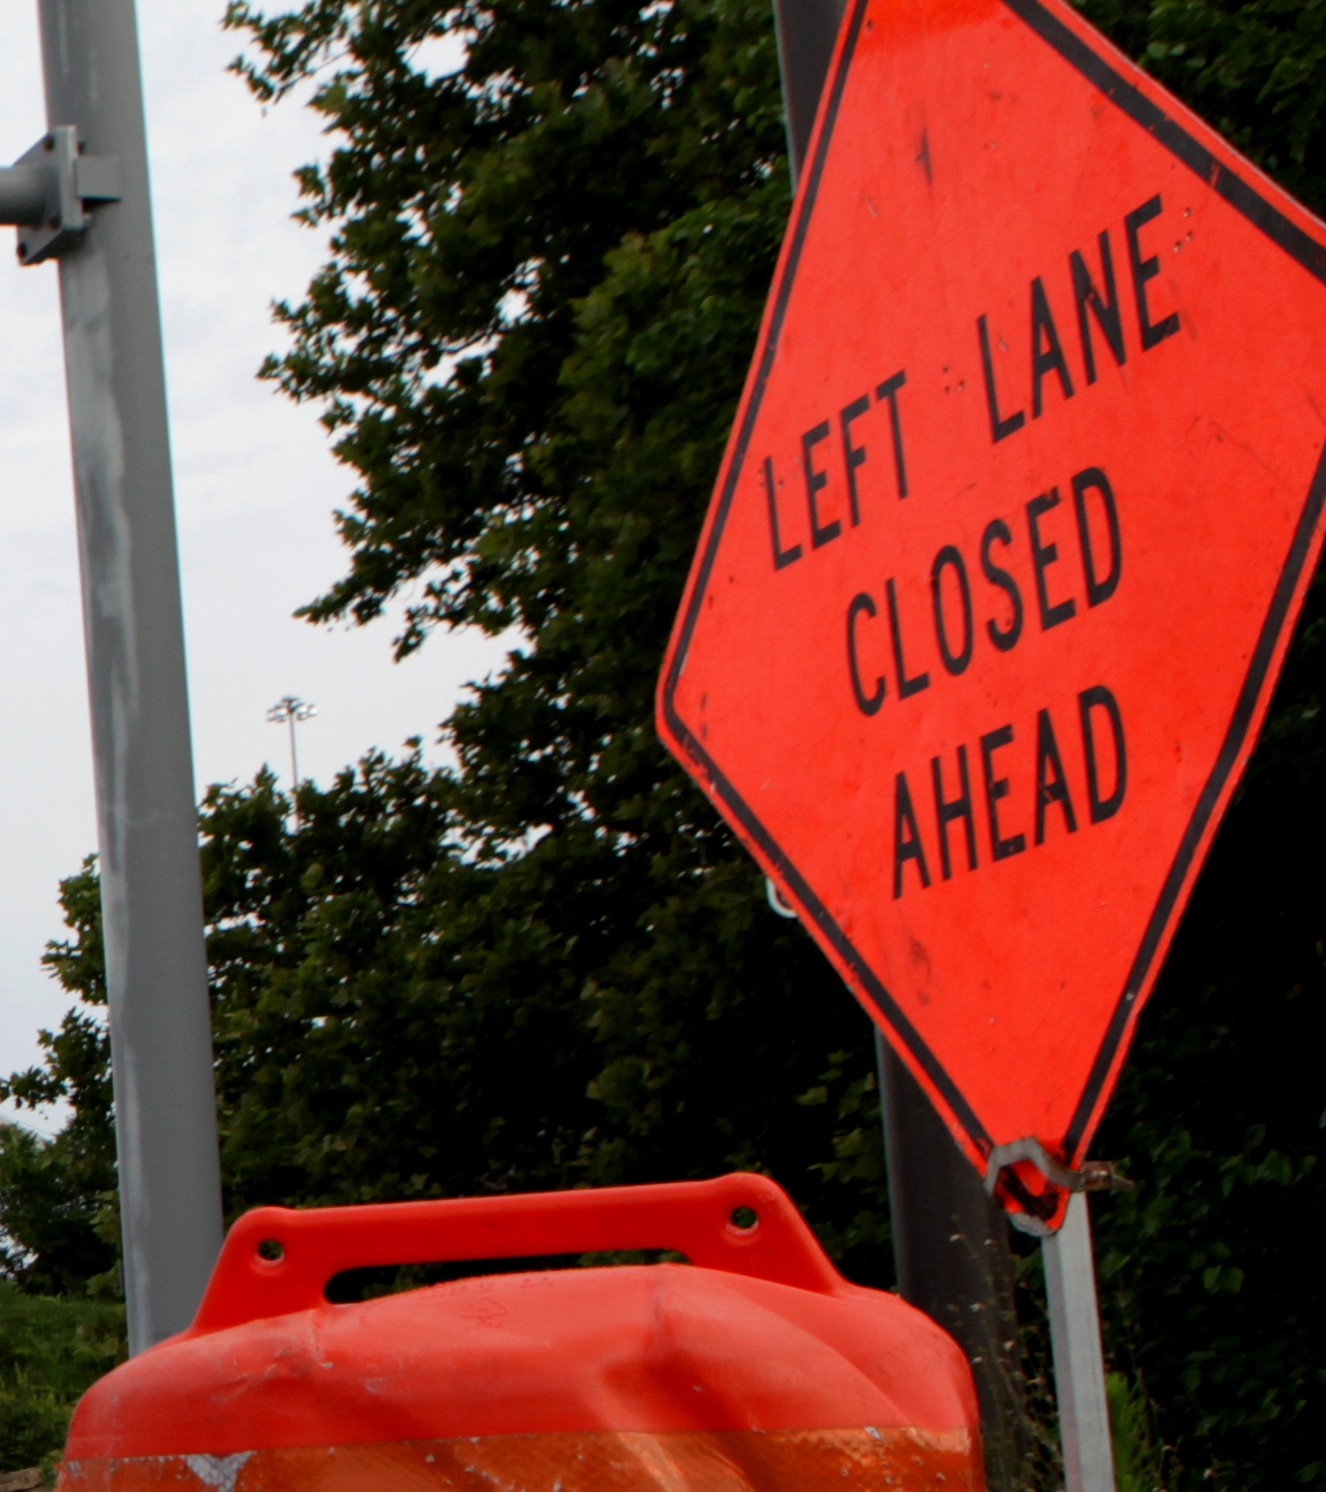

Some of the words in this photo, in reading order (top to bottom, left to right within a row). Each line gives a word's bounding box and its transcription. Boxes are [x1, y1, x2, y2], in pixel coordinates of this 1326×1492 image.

[762, 369, 909, 572] LEFT
[976, 194, 1182, 445] LANE
[844, 465, 1124, 717] CLOSED
[892, 684, 1129, 901] AHEAD
